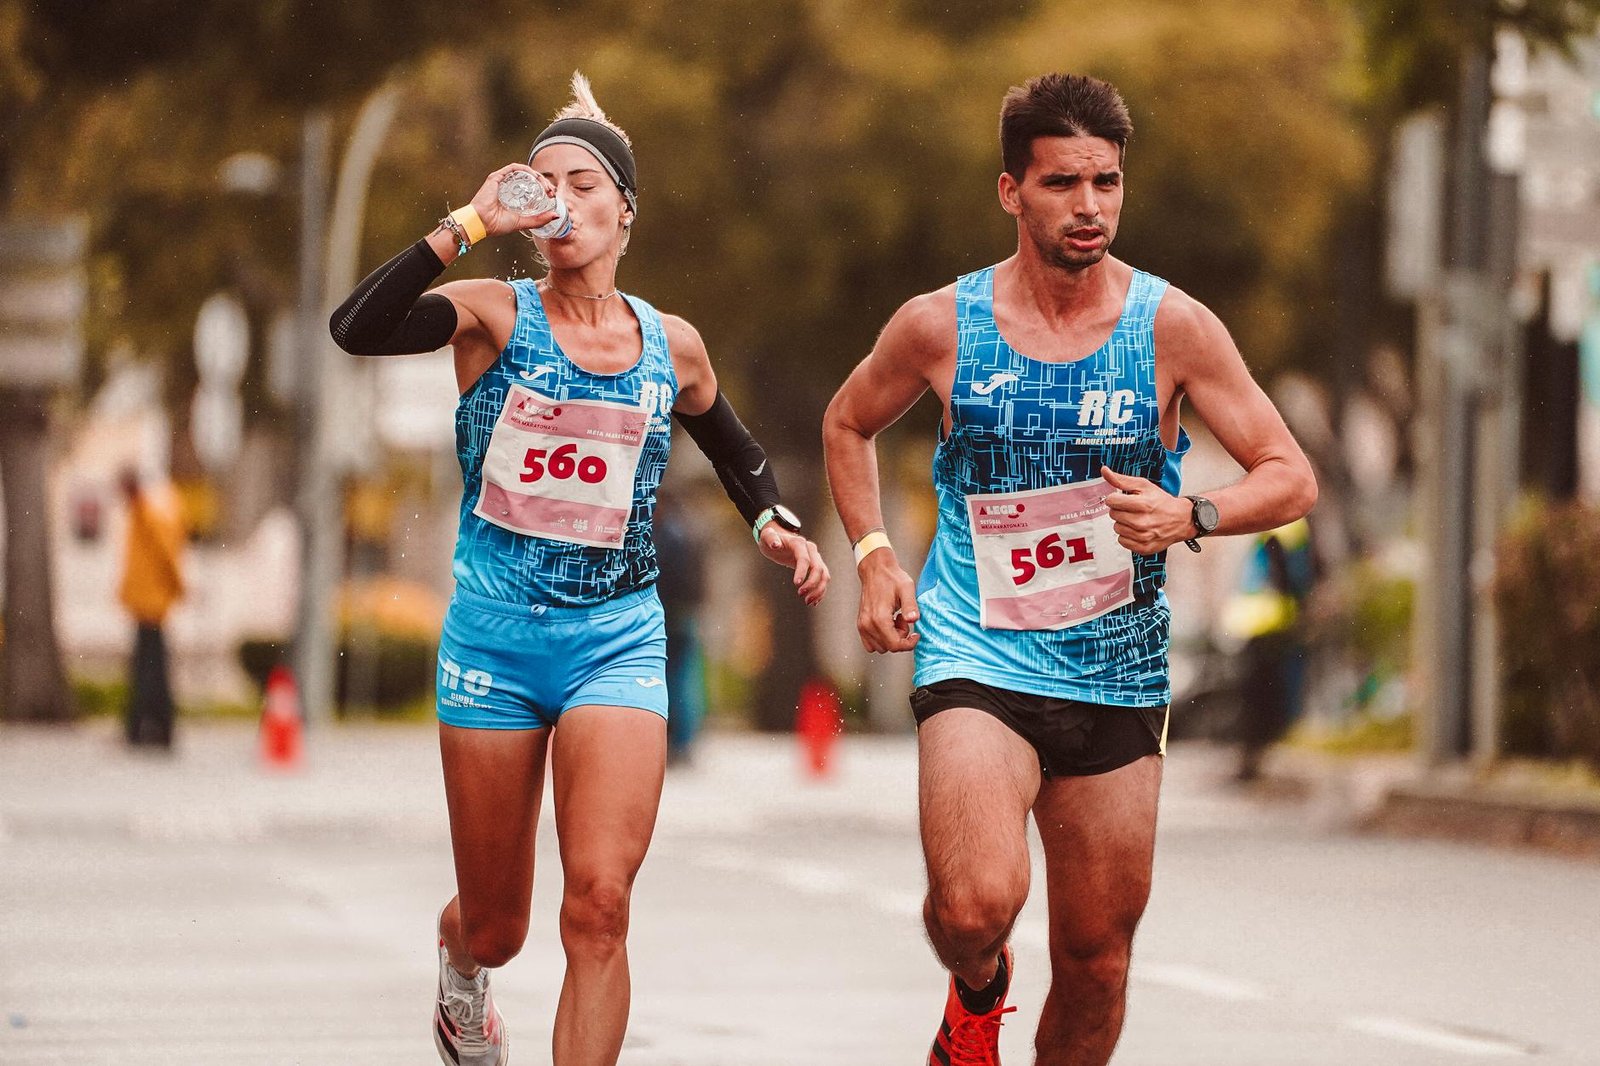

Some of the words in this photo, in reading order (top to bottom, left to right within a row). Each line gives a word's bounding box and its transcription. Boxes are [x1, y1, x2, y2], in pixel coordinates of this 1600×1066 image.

[1077, 389, 1135, 427] RC
[1075, 438, 1104, 446] RAQUEL
[1094, 428, 1118, 436] CLUBE
[518, 443, 607, 484] 560
[979, 503, 1025, 519] ALEGRO
[1011, 532, 1095, 586] 561
